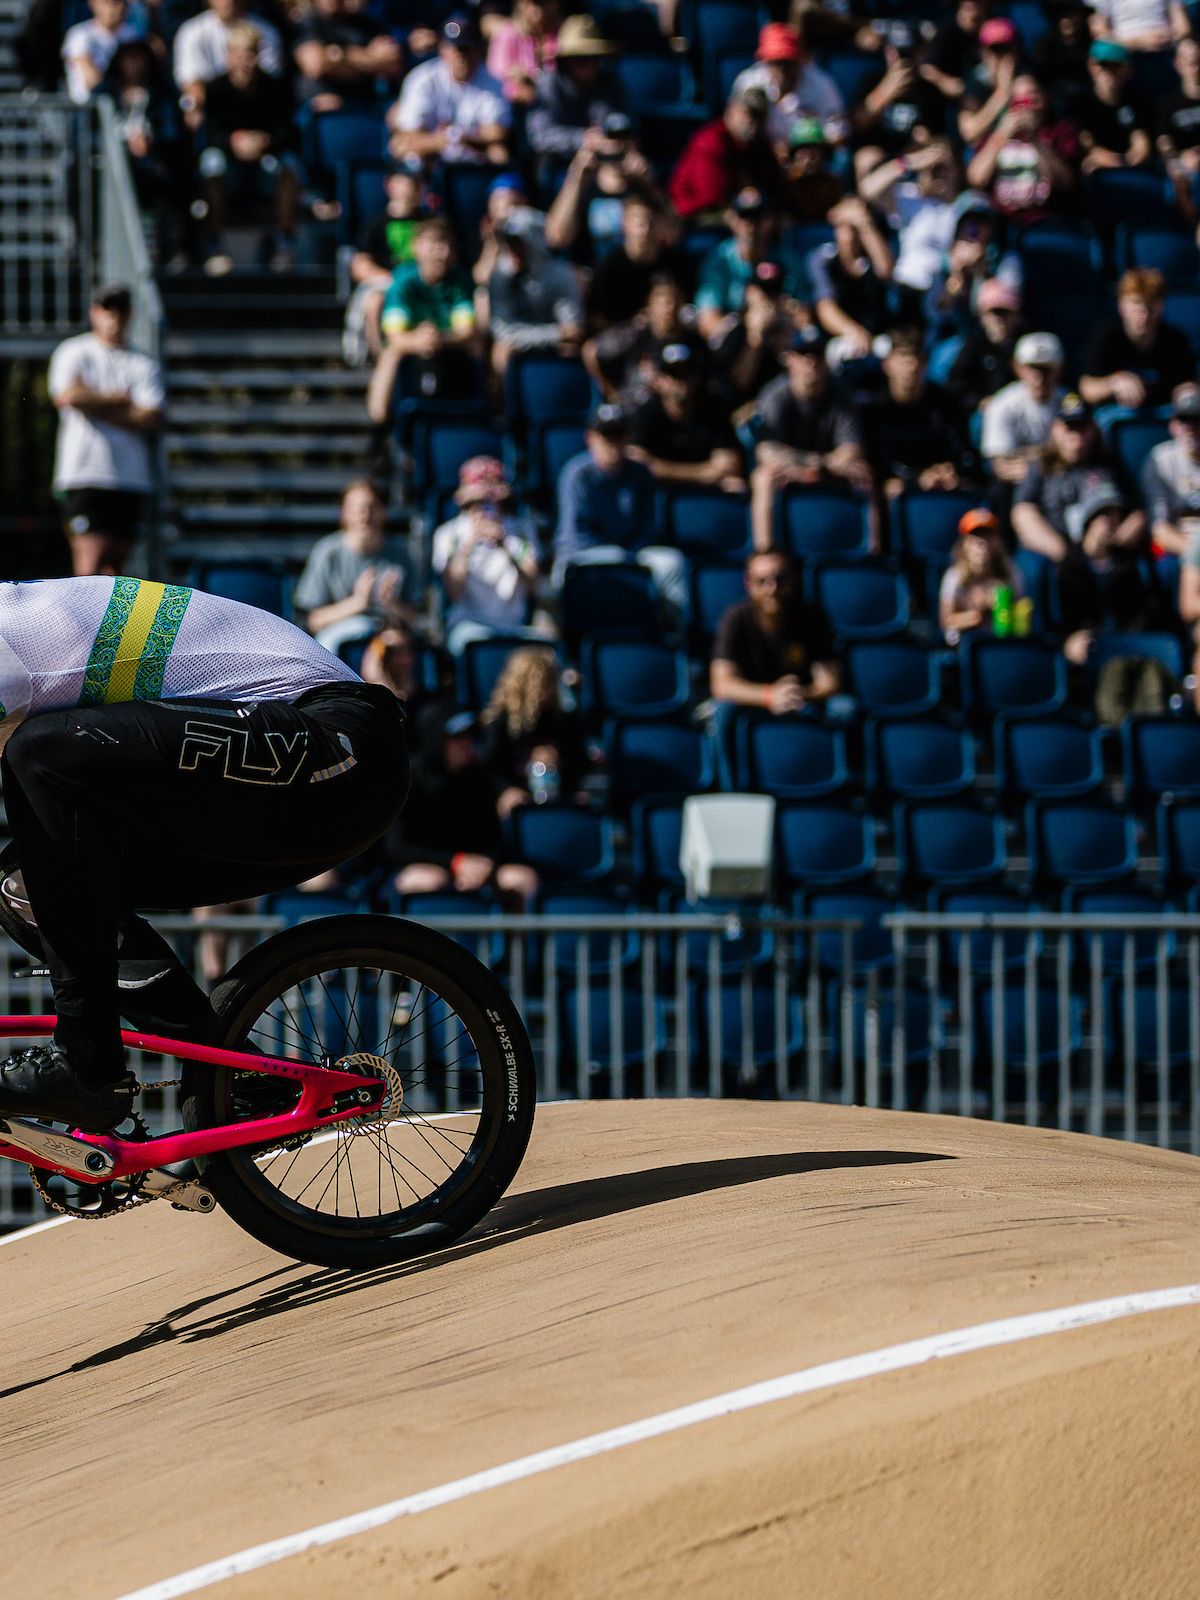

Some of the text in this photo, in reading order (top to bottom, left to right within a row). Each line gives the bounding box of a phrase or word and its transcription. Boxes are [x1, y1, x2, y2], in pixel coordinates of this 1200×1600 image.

[179, 720, 309, 785] FLY
[263, 1062, 309, 1078] TERRA
[495, 1024, 519, 1112] SCHWALBE SX-R
